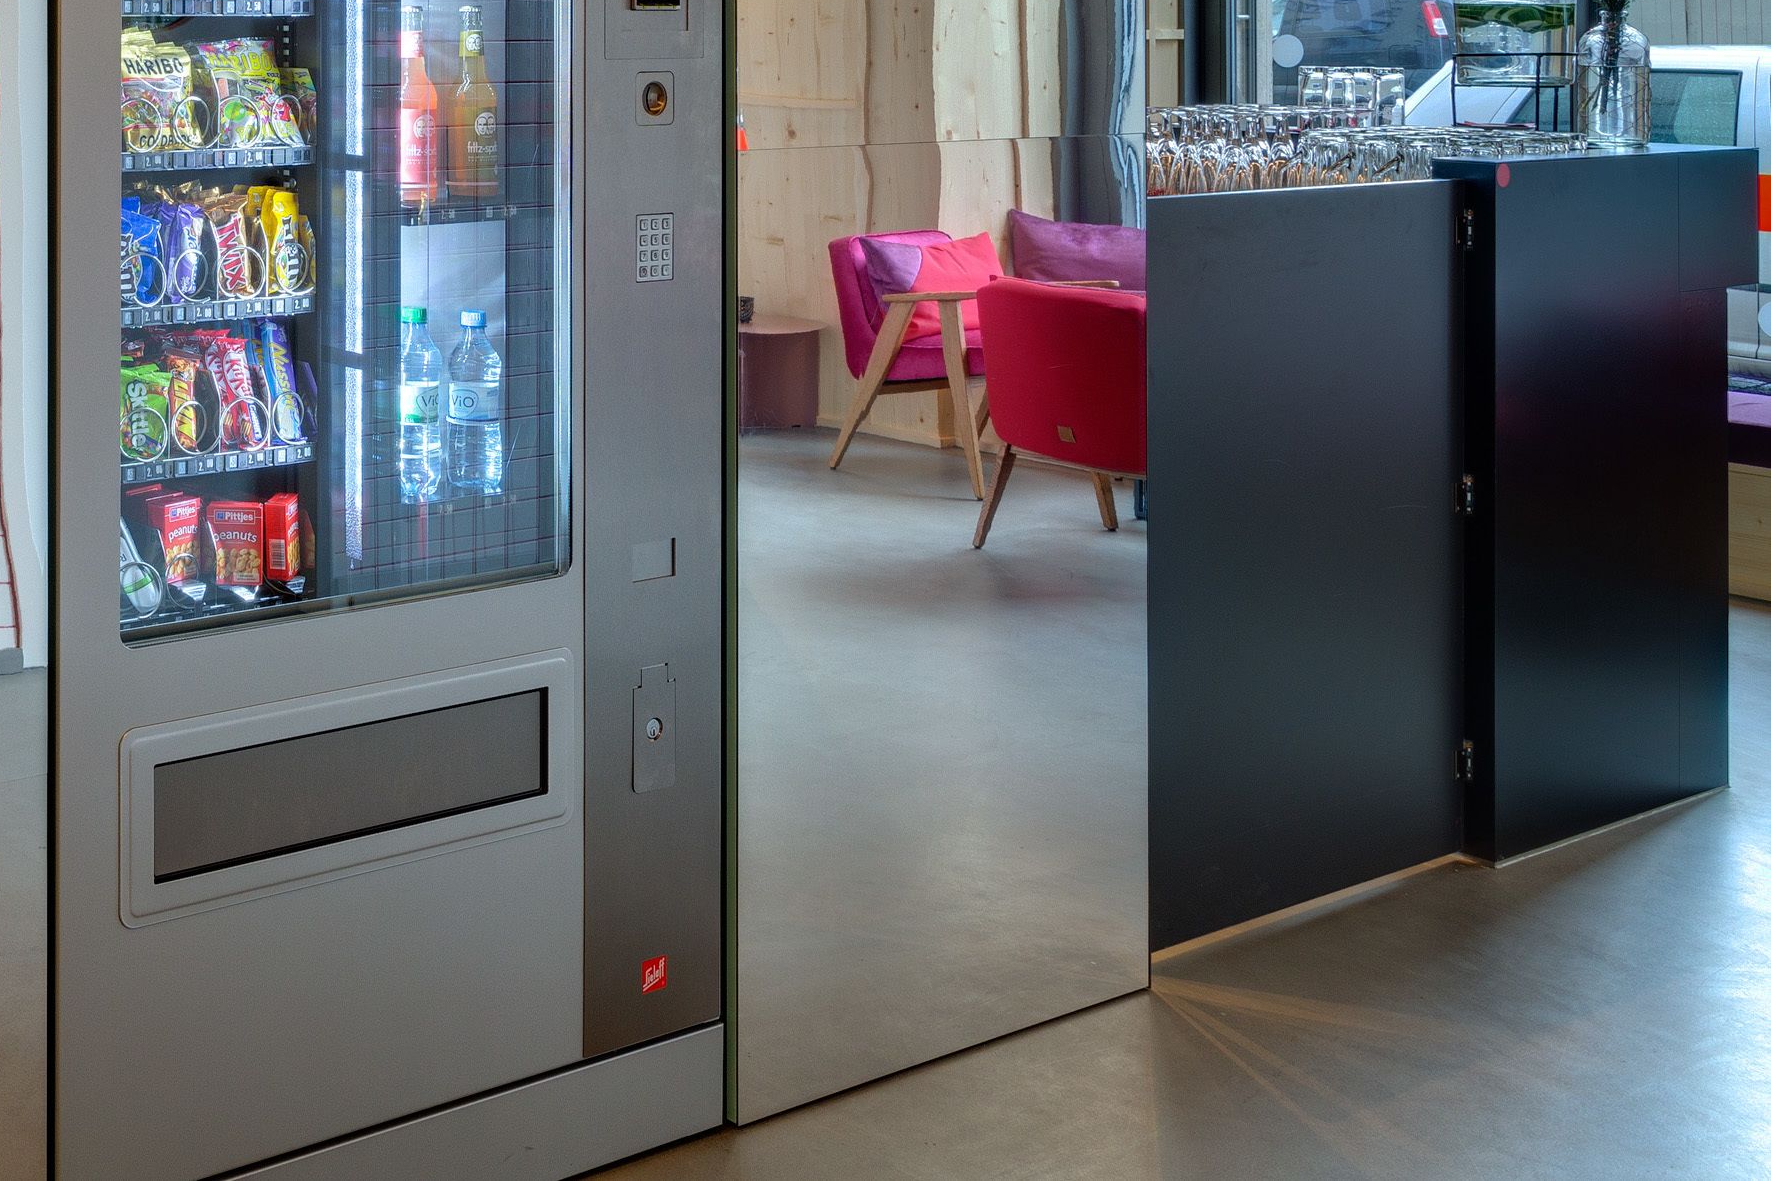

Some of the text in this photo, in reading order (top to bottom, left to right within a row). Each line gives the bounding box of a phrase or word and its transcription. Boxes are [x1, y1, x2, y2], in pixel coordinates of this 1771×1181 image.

[124, 57, 184, 76] HARIBO
[206, 51, 273, 72] HARIBO
[217, 216, 246, 290] TWIX
[225, 511, 254, 522] Pittjes
